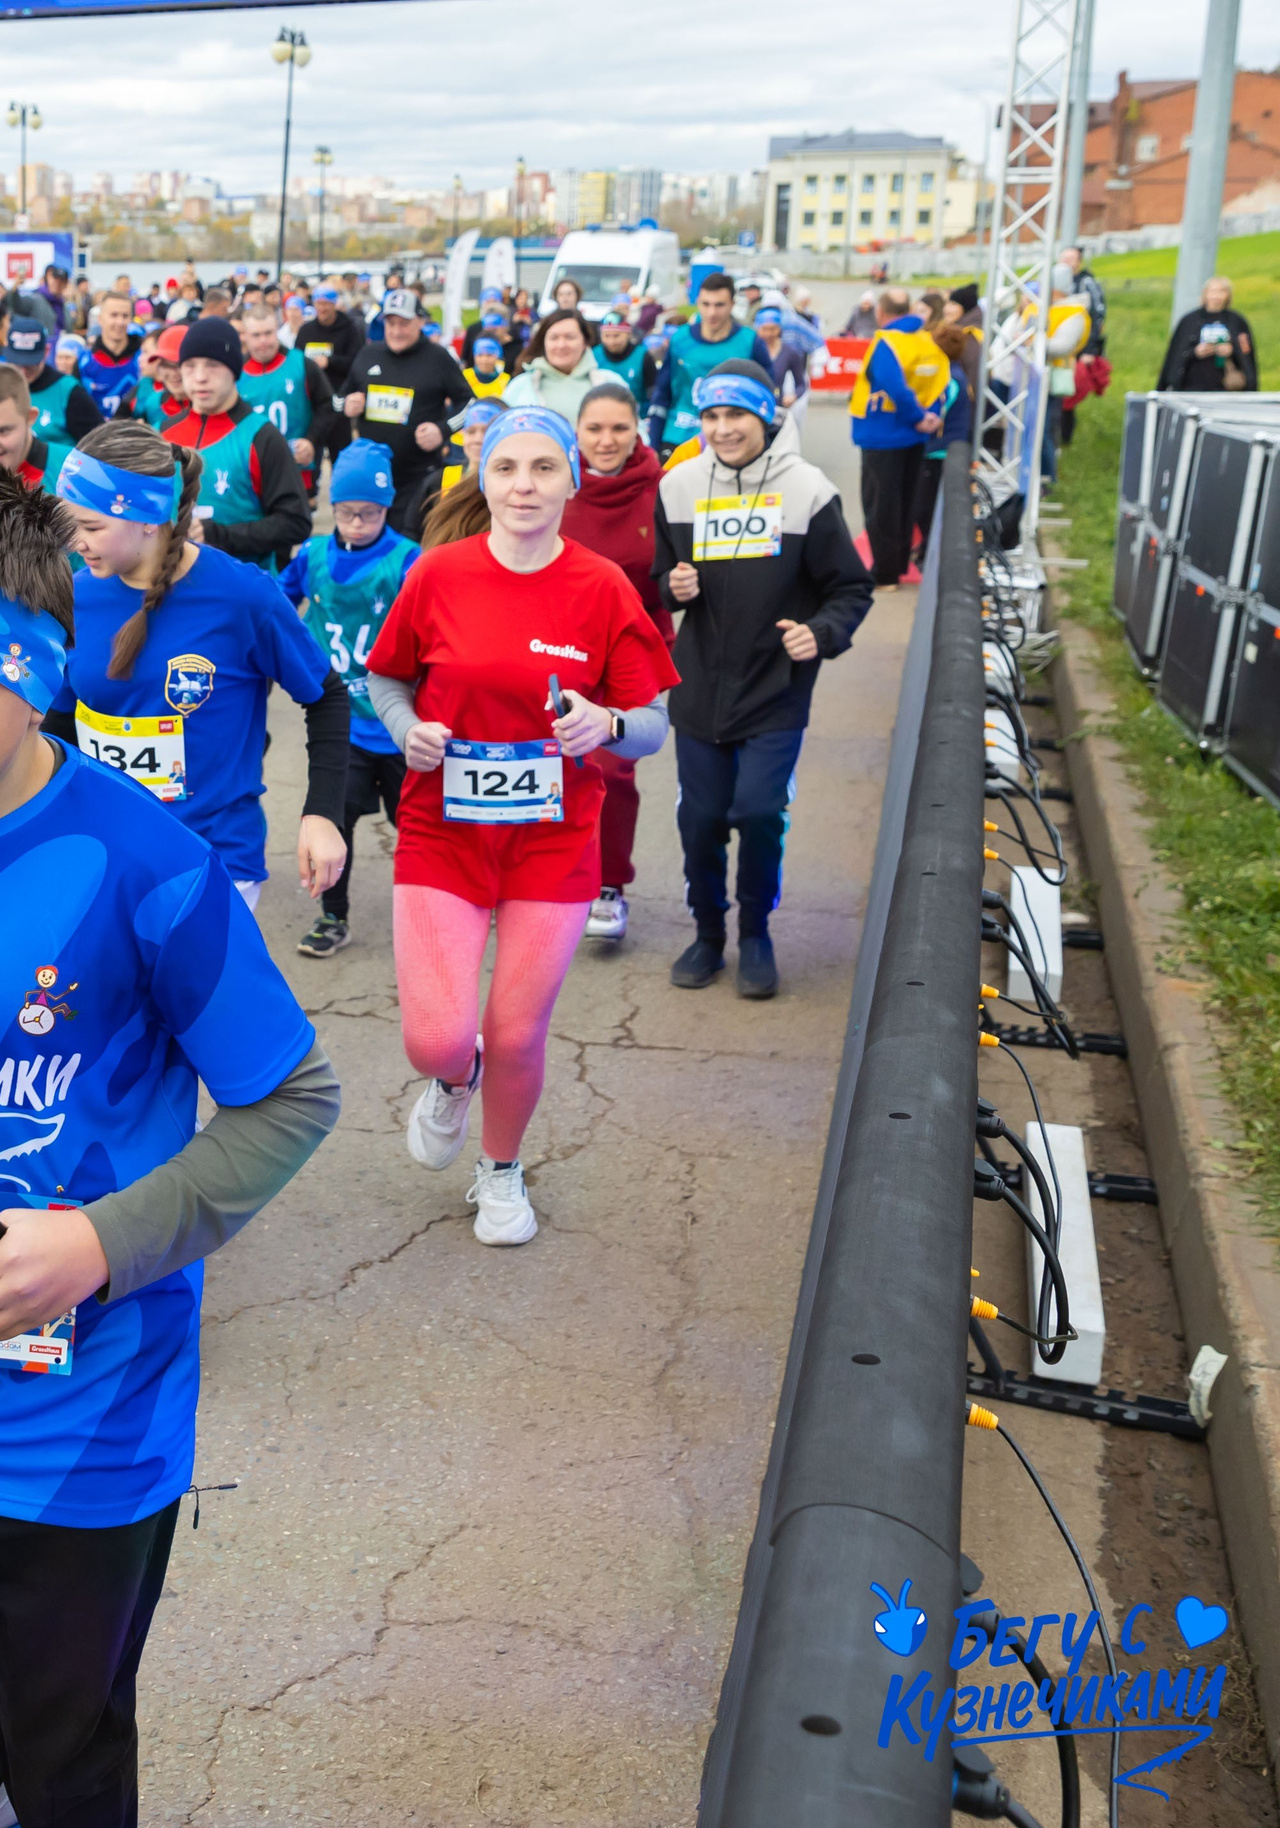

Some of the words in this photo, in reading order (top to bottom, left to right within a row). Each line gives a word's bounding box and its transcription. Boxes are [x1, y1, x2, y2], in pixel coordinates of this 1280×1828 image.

[253, 400, 288, 436] 0
[707, 516, 766, 538] 100
[89, 738, 162, 773] 134
[464, 769, 540, 796] 124
